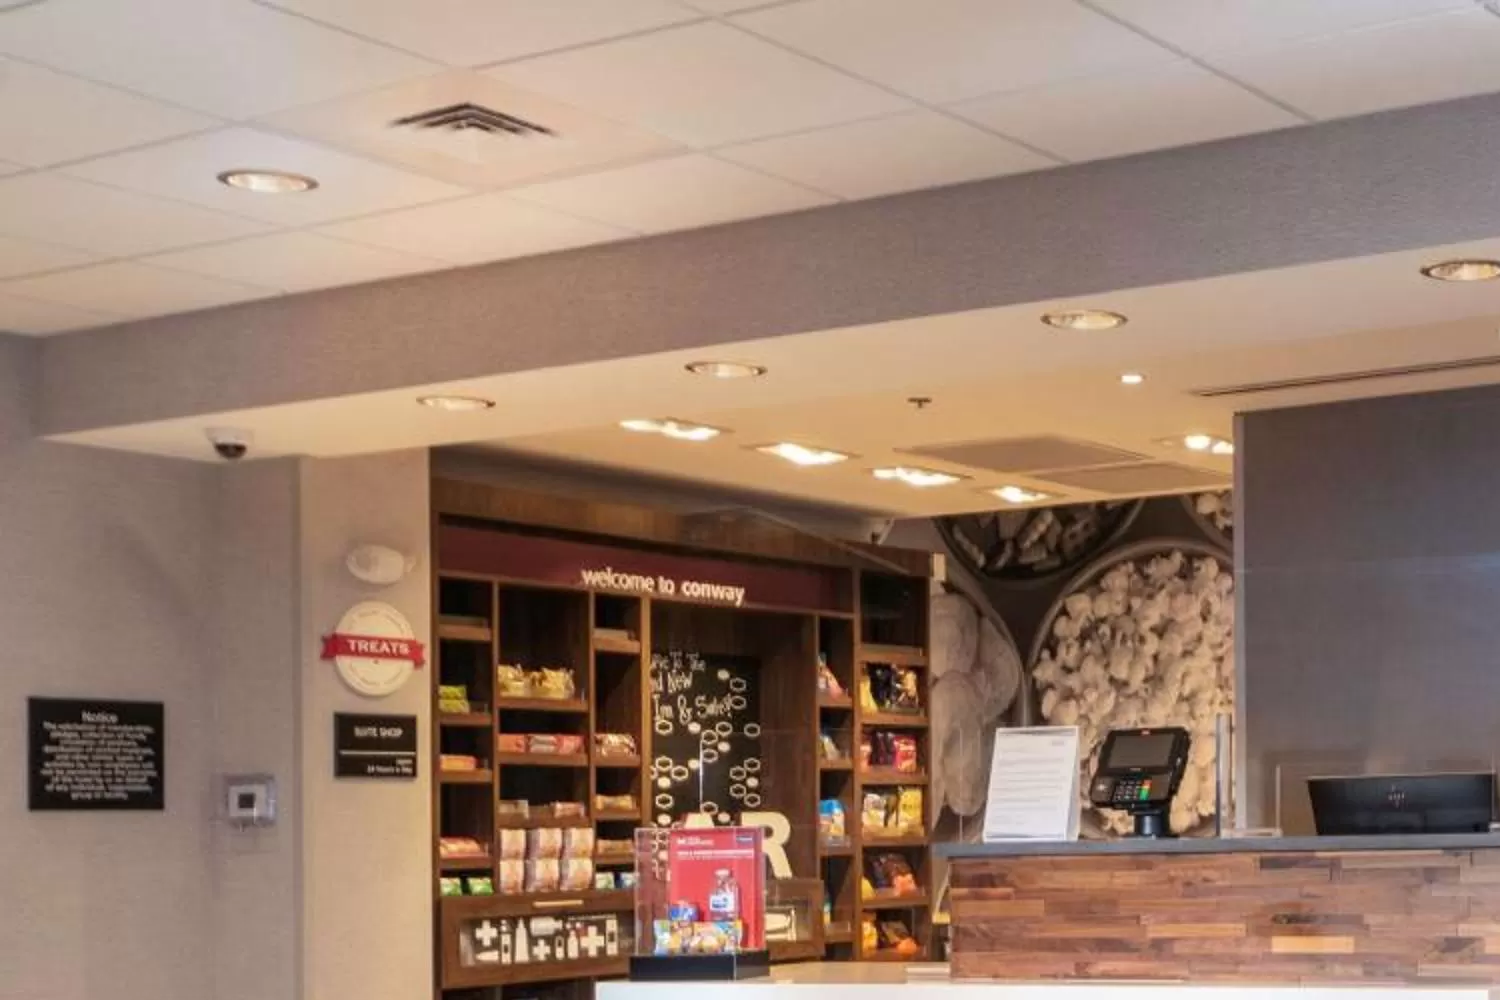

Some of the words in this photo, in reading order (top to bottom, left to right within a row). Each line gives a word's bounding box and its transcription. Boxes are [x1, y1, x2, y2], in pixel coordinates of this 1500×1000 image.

[581, 567, 654, 593] welcome
[658, 576, 675, 595] to
[681, 581, 745, 607] conway
[347, 639, 410, 655] TREATS
